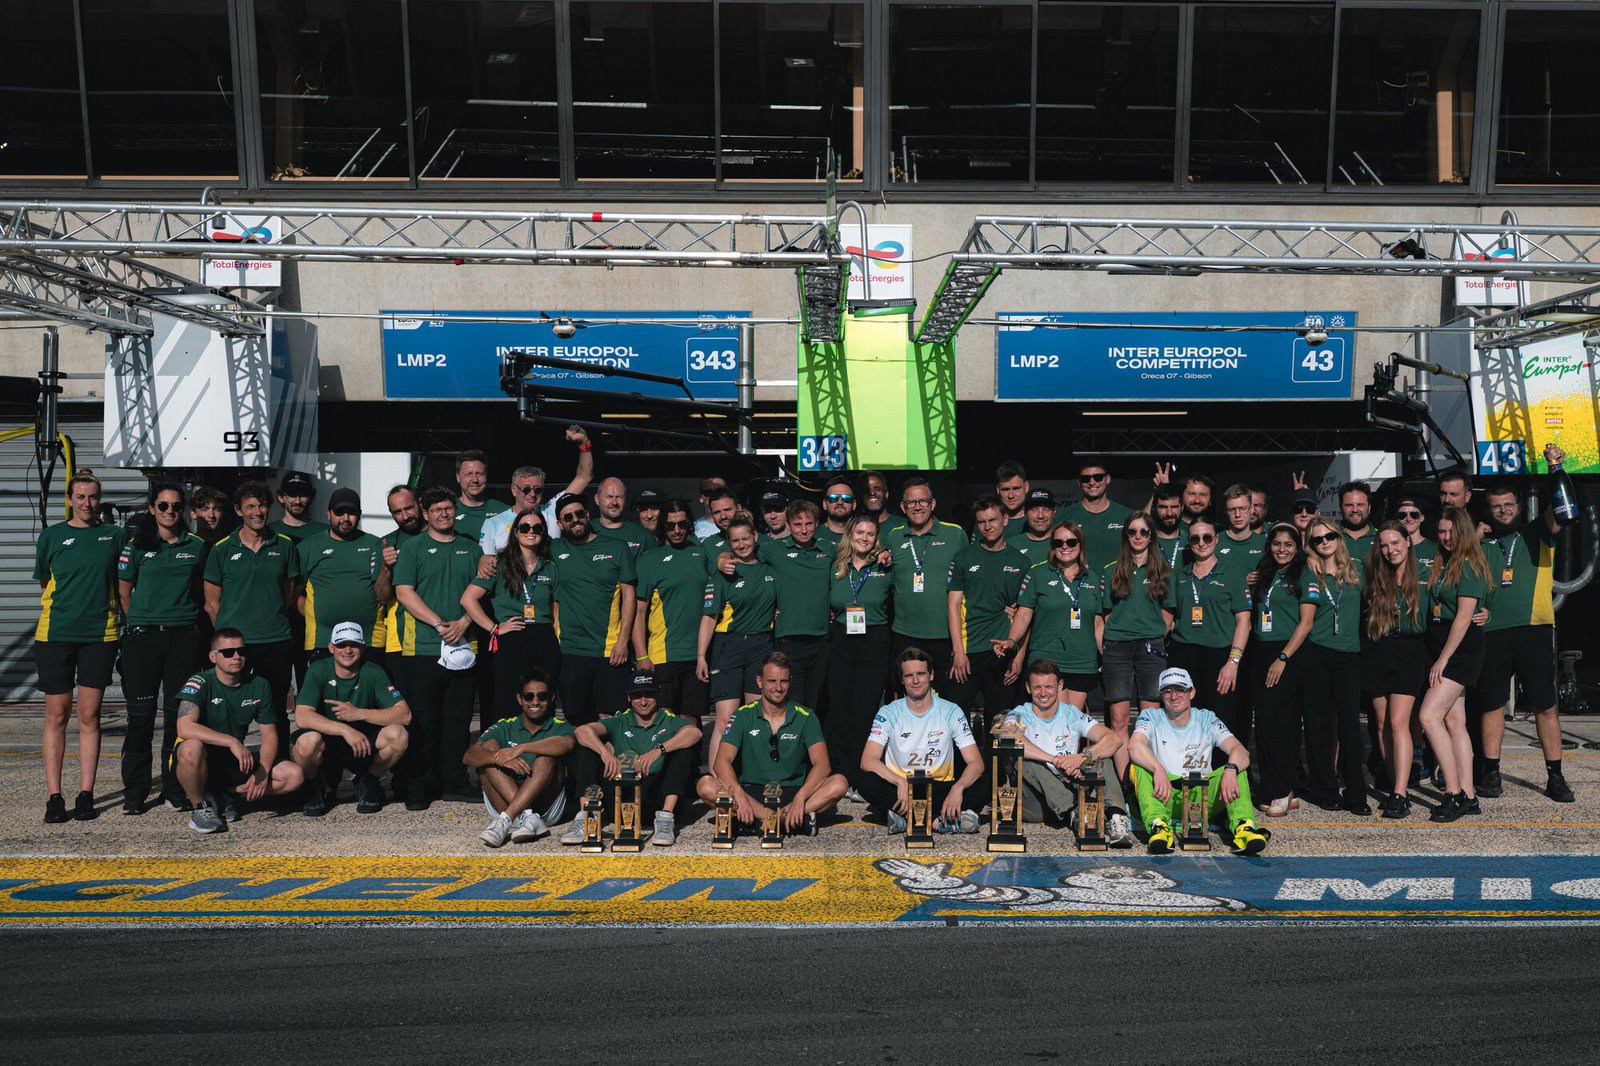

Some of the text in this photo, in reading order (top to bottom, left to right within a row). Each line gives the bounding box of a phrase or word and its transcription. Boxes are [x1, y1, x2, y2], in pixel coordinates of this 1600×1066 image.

[211, 260, 272, 271] TotalEnergies
[848, 274, 905, 284] otaEnergies
[1464, 280, 1519, 290] TotalEnergie
[553, 346, 639, 357] EUROPOL
[1108, 347, 1247, 358] INTER EUROPOL
[397, 353, 447, 367] LMP2
[690, 350, 736, 371] 343
[1010, 354, 1059, 368] LMP2
[1115, 358, 1239, 369] COMPETITION
[1301, 350, 1334, 371] 43
[1522, 355, 1583, 380] Europol
[223, 431, 260, 453] 93
[802, 437, 846, 468] 343
[1481, 442, 1522, 473] 43
